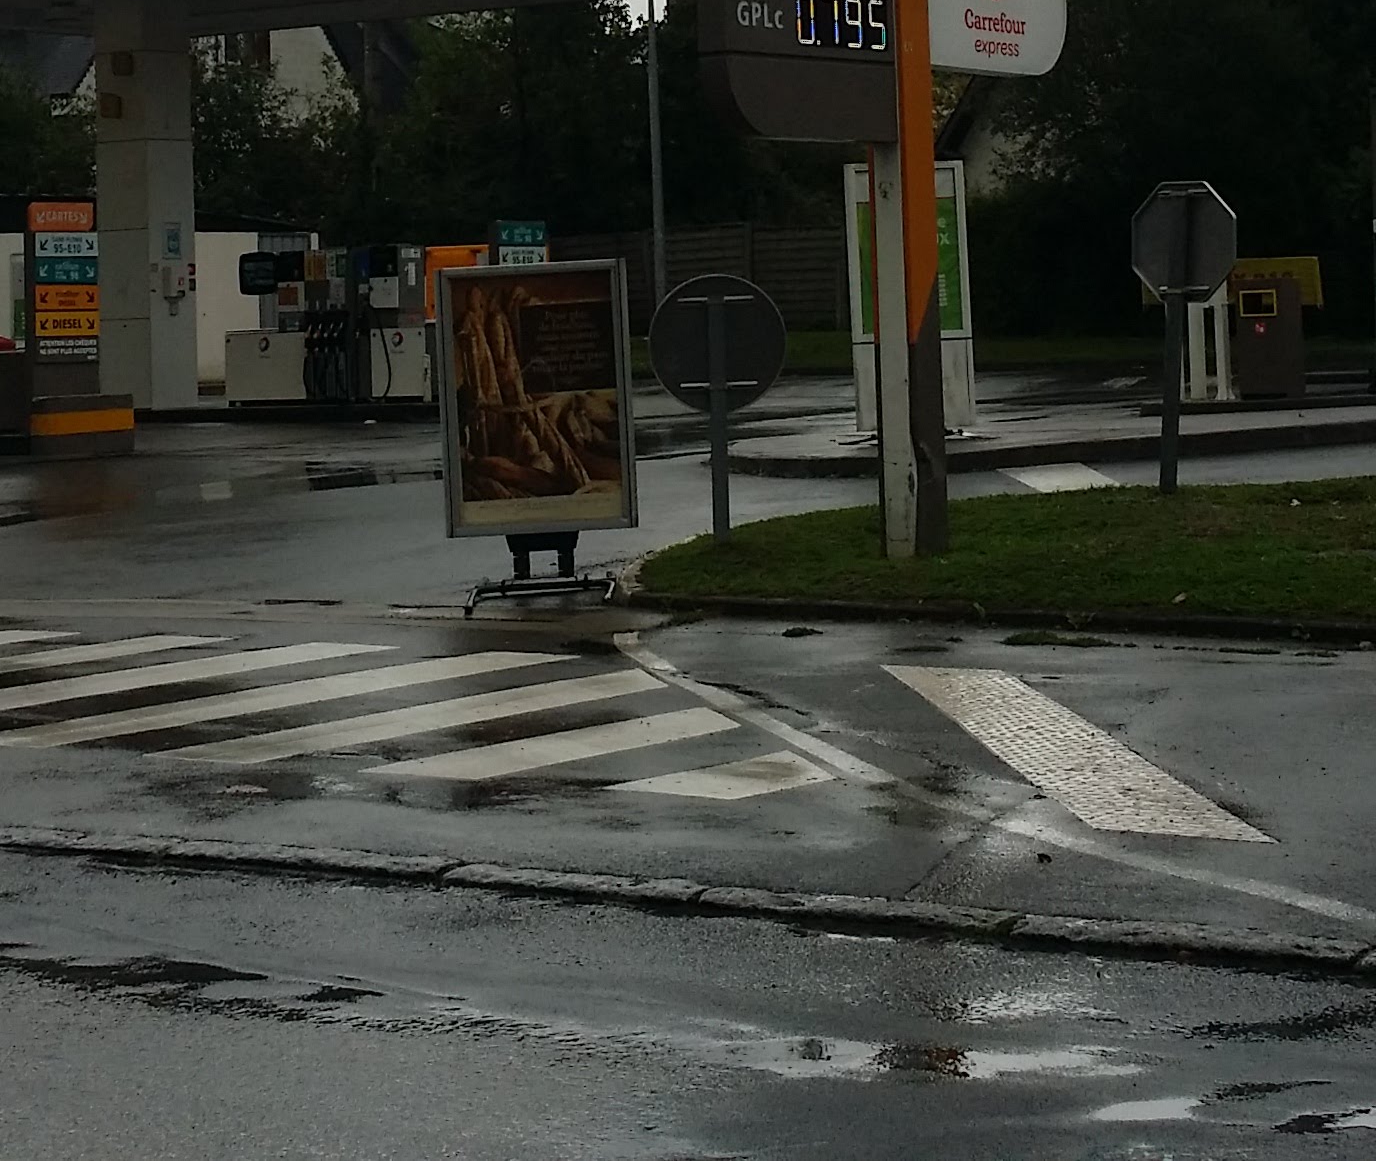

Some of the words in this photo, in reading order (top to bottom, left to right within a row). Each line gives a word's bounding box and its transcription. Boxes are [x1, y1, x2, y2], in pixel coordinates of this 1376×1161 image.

[964, 8, 1026, 36] Carrefour
[974, 38, 1020, 58] express
[52, 319, 82, 329] DIESEL
